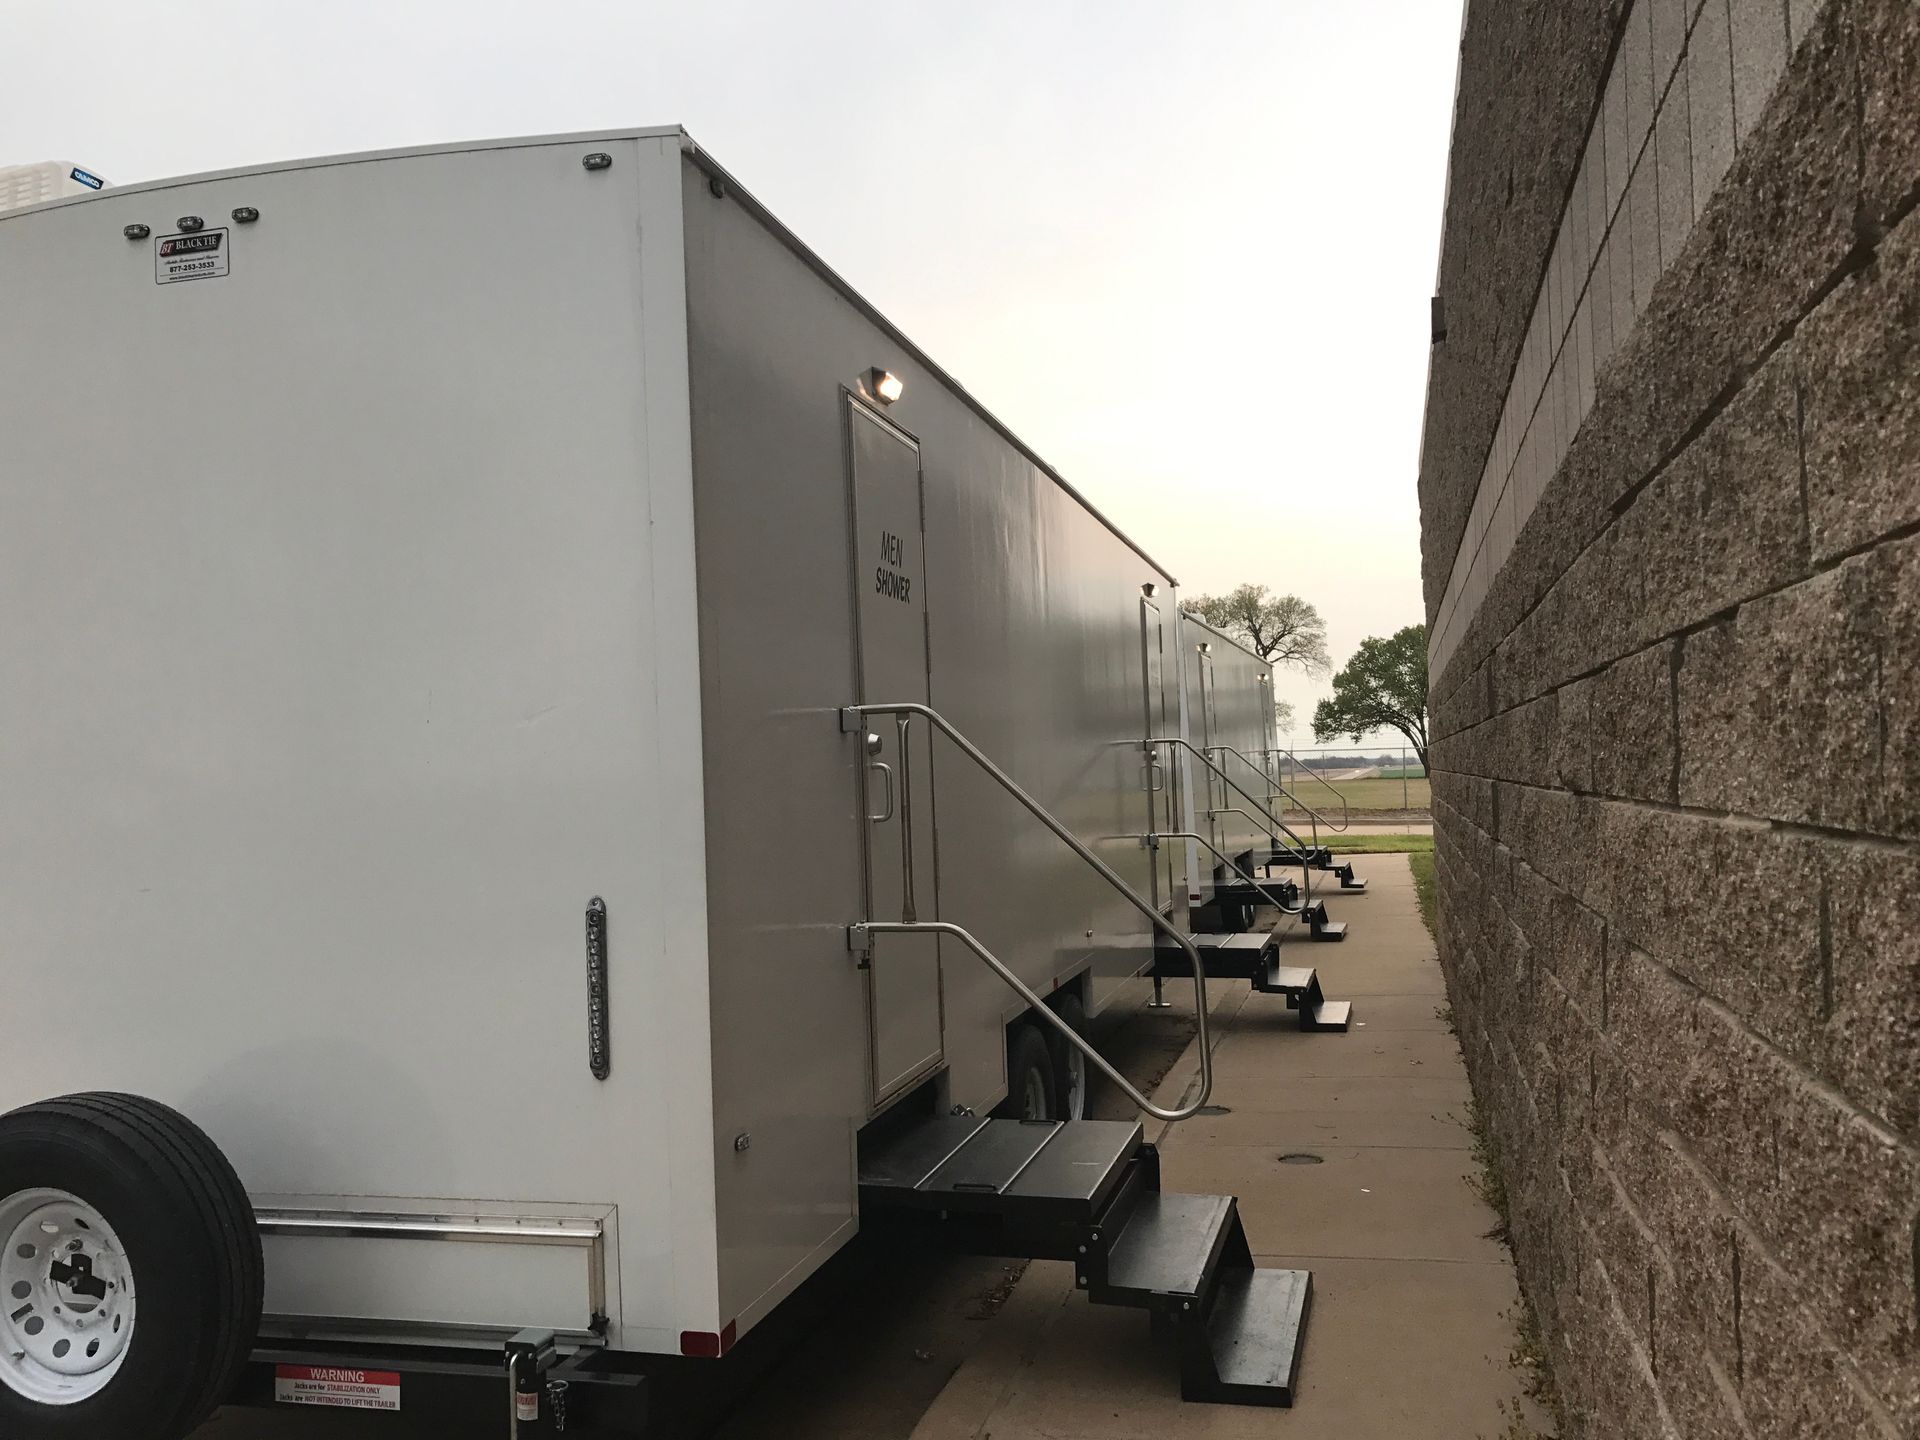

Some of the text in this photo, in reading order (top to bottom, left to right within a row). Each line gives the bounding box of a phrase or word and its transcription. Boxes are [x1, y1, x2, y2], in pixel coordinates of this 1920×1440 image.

[161, 242, 173, 254] BT
[176, 238, 202, 249] BLACK
[204, 236, 217, 246] TIE
[881, 531, 903, 568] MEN
[876, 566, 910, 604] SHOWER
[310, 1368, 365, 1383] WARNING
[294, 1382, 308, 1390] Jacks
[317, 1383, 325, 1391] for
[327, 1384, 365, 1394] STABILIZATION
[366, 1387, 380, 1395] ONLY
[305, 1395, 316, 1403] NOT
[317, 1396, 343, 1405] INTENDED
[352, 1398, 363, 1406] LIFT
[363, 1399, 374, 1407] THE
[374, 1400, 396, 1408] TRAILER
